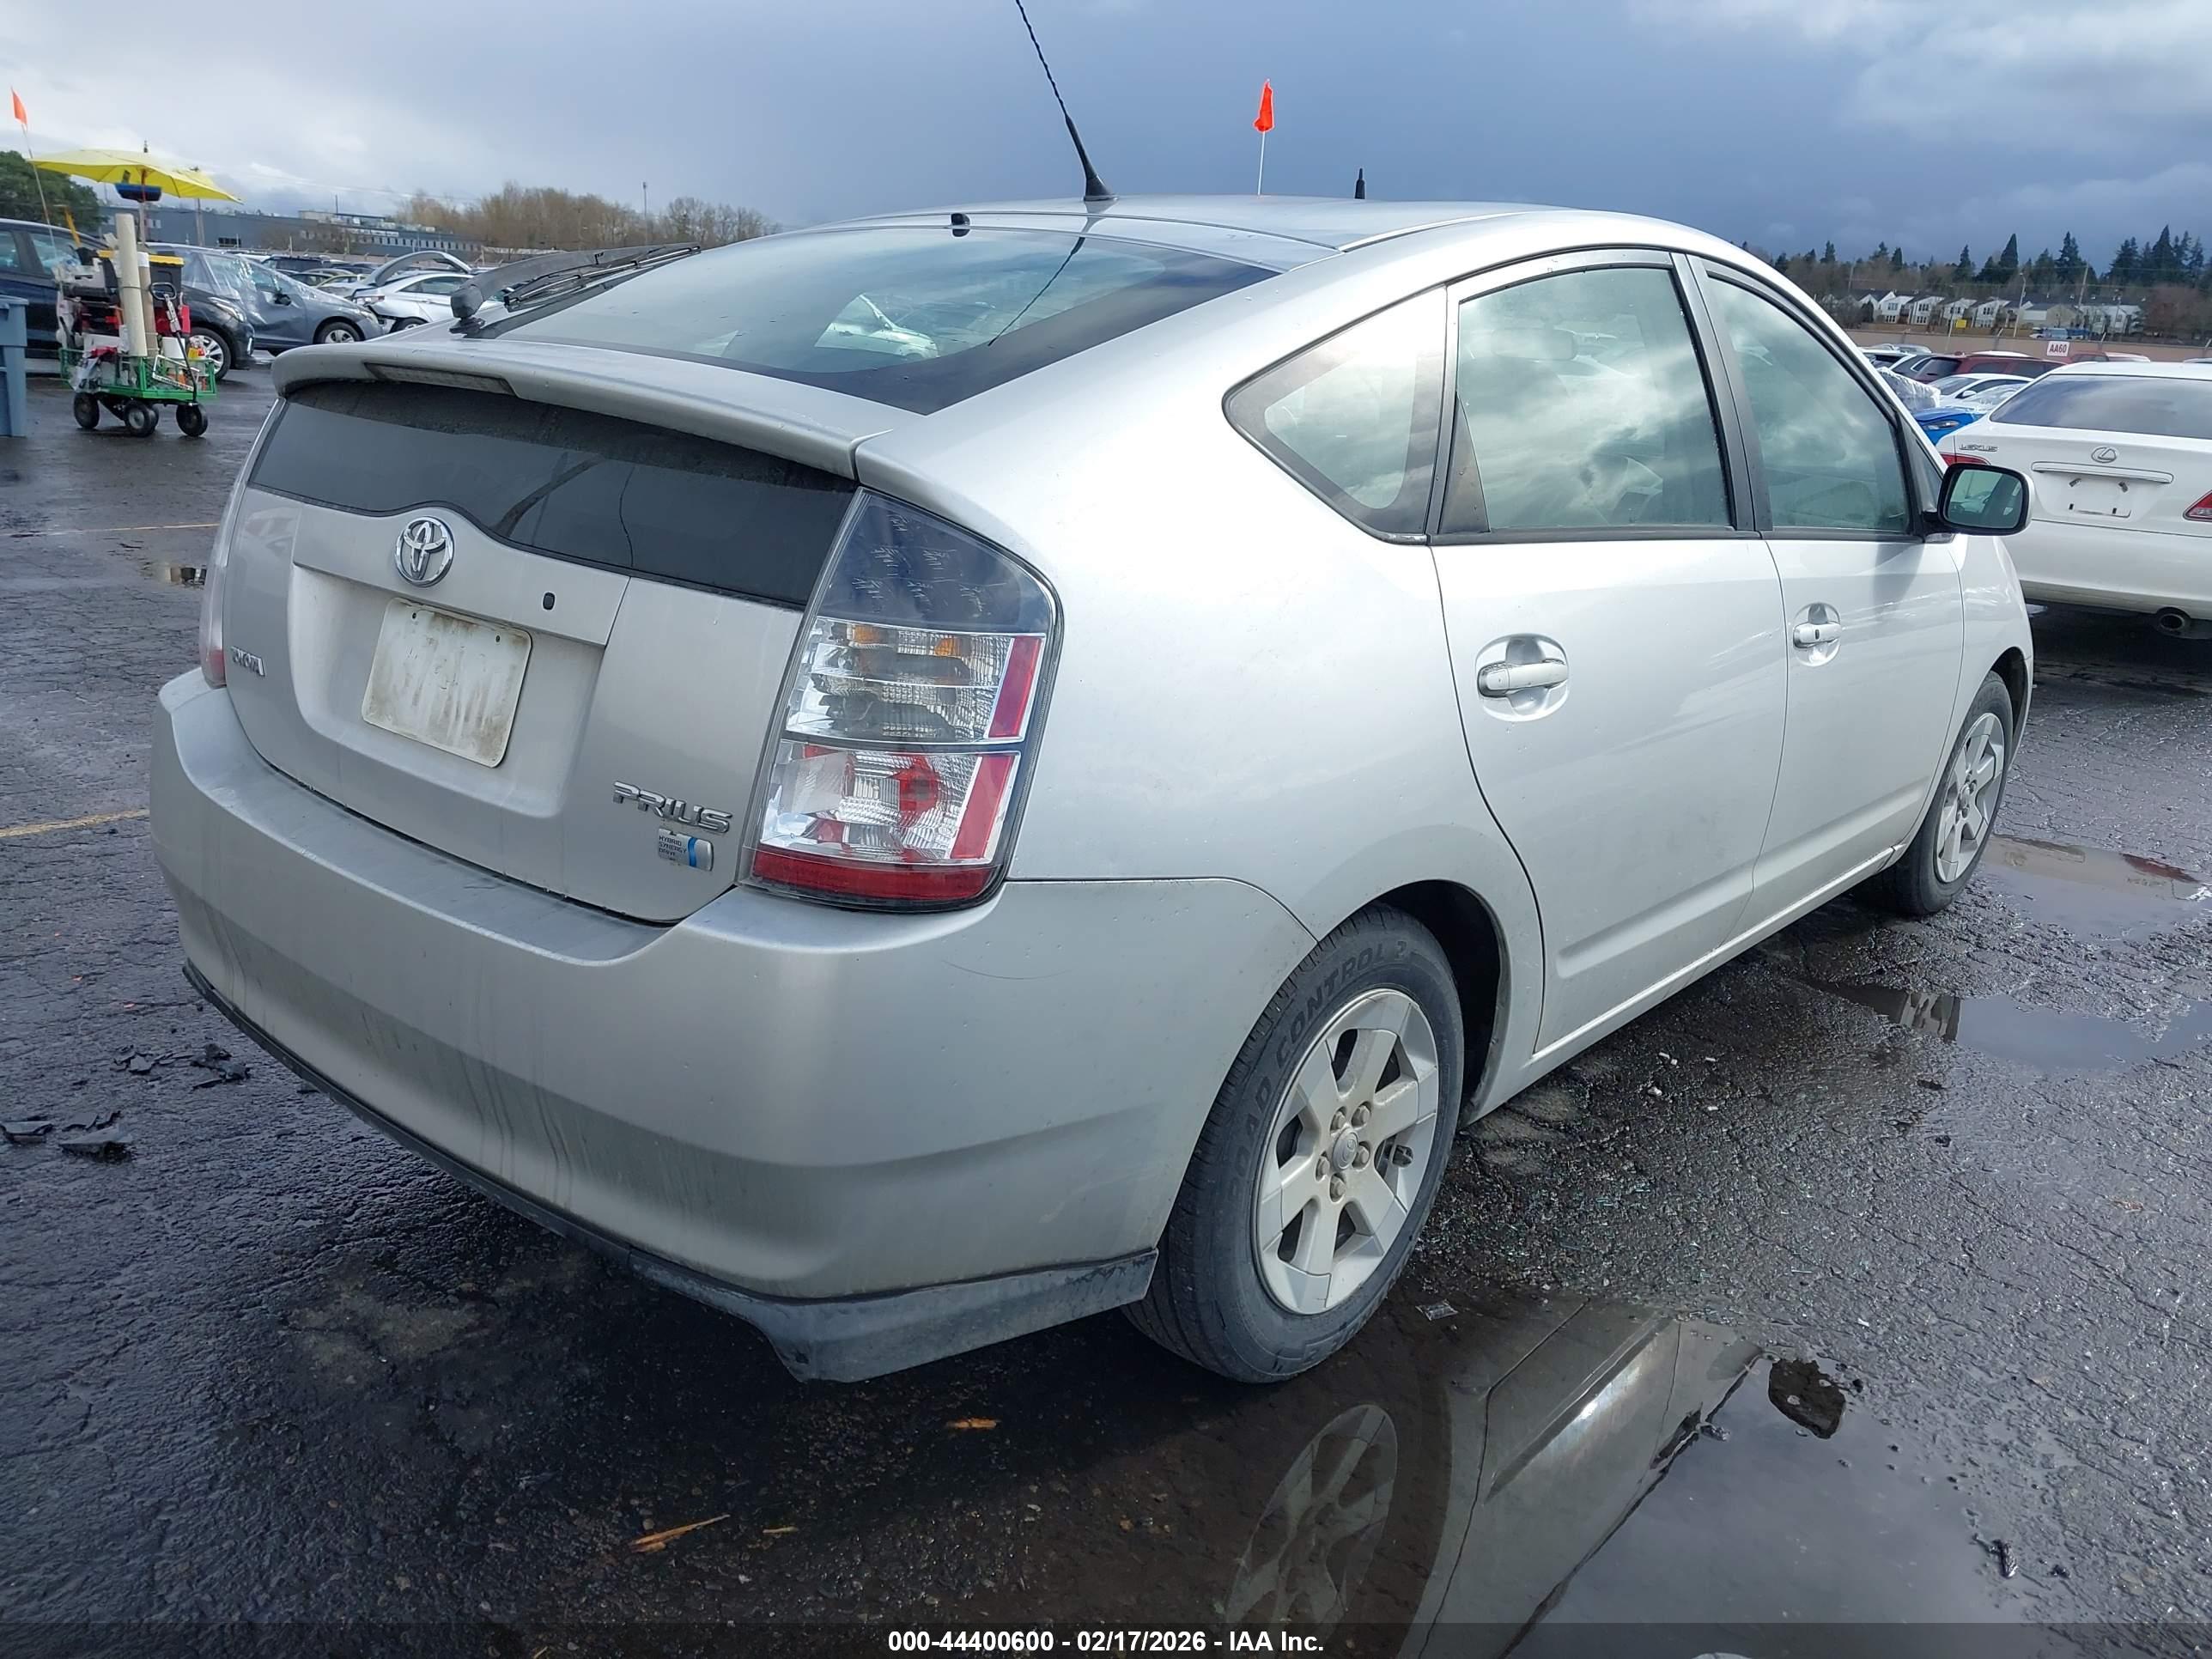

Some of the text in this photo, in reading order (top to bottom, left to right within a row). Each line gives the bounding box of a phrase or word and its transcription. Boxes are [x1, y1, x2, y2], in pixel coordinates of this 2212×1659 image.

[2049, 343, 2068, 353] AA60
[1959, 444, 1998, 453] LEXUS
[611, 780, 733, 834] PRIUS
[659, 836, 683, 847] HYBRID
[1276, 941, 1385, 1068] CONTROL
